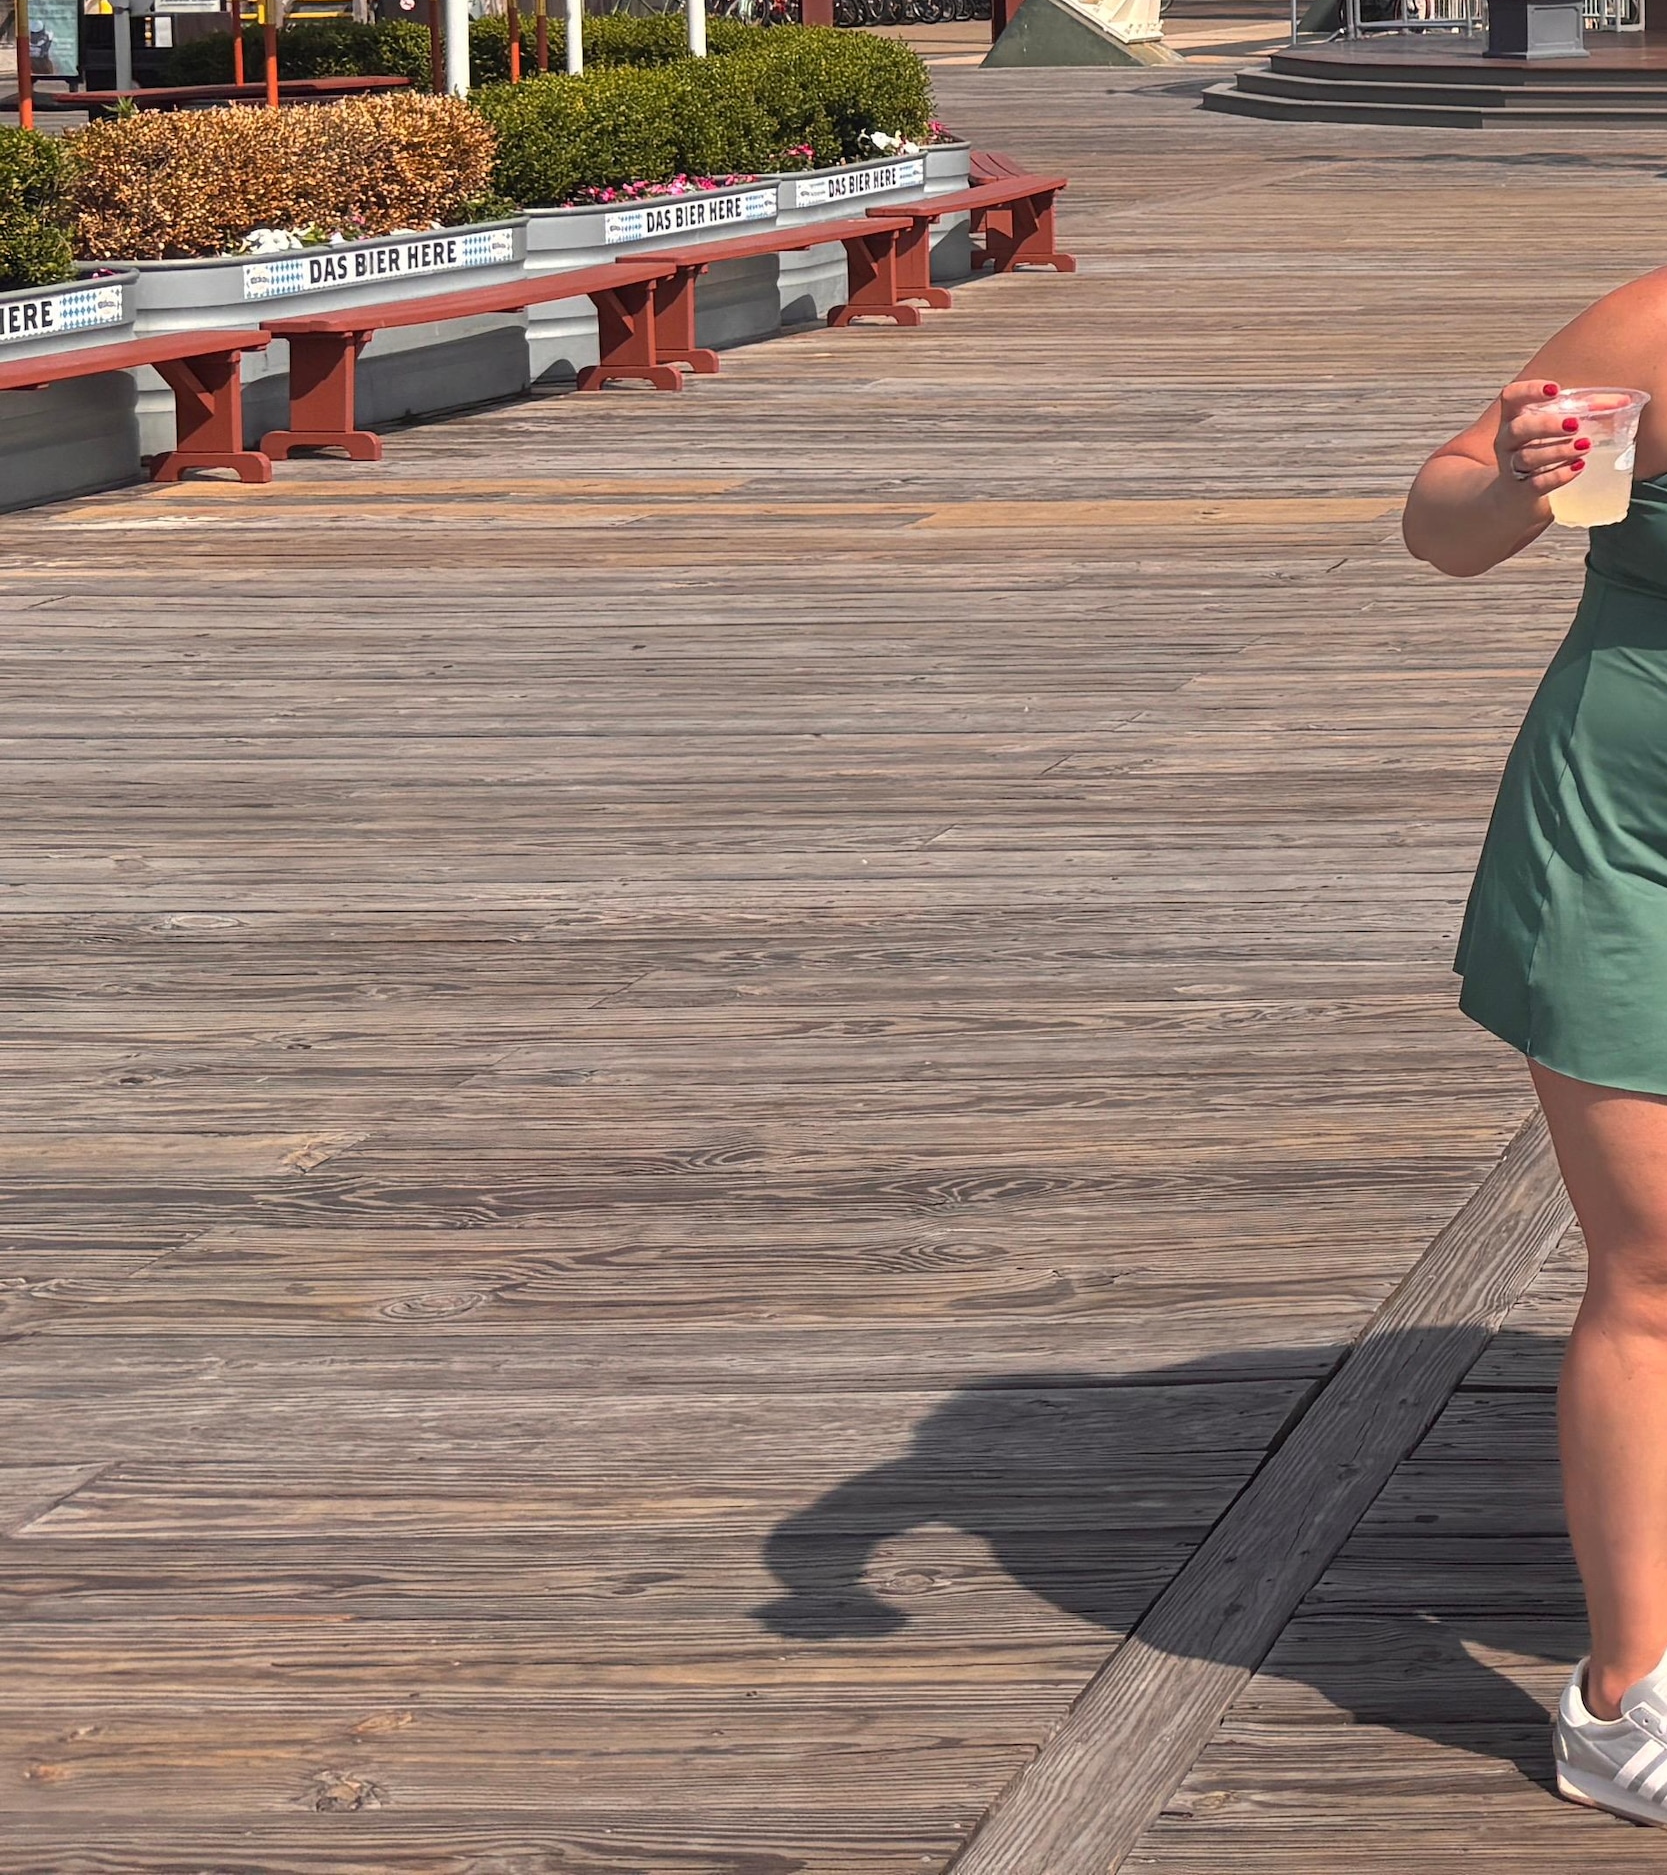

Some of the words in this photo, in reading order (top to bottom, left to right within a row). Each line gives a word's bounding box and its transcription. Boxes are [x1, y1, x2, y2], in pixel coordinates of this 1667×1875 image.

[829, 178, 846, 198] DAS
[849, 172, 870, 195] BIER
[873, 166, 896, 190] HERE
[646, 209, 671, 233] DAS
[676, 203, 704, 228] BIER
[709, 197, 741, 222] HERE
[309, 253, 348, 285] DAS
[355, 246, 400, 277] BIER
[407, 240, 457, 270] HERE
[0, 300, 53, 334] ERE
